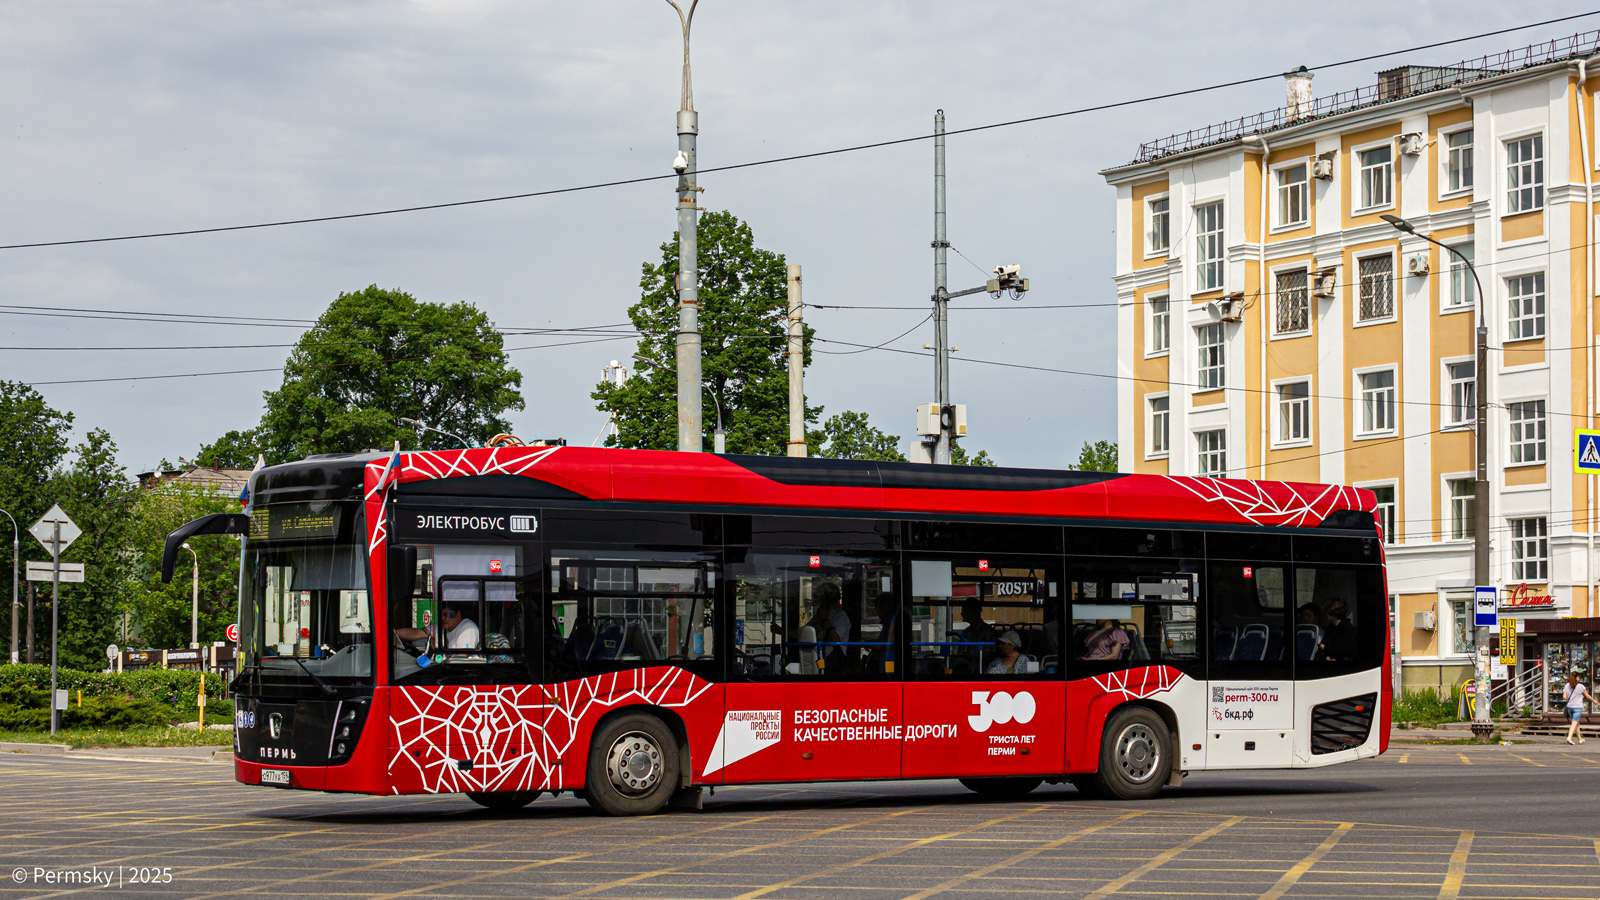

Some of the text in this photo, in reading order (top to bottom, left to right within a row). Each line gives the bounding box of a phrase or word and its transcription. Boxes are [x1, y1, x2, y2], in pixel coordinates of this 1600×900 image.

[417, 515, 505, 530] ЭЛЕКТРОБУС
[1512, 583, 1555, 606] Саша
[1500, 619, 1508, 664] ЦВЕТЫ
[1508, 619, 1516, 664] ЦВЕТЫ
[1225, 692, 1278, 704] perm-300.ru
[728, 711, 780, 722] НАЦИОНАЛЬНЫЕ
[794, 708, 888, 724] БЕЗОПАСНЫЕ
[967, 691, 1036, 732] 300
[1224, 708, 1254, 720] бкд.рф
[750, 721, 780, 731] ПРОЕКТЫ
[755, 731, 780, 741] РОССИИ
[794, 724, 957, 742] КАЧЕСТВЕННЫЕ ДОРОГИ
[988, 735, 1036, 744] ТРИСТА ЛЕТ
[260, 747, 297, 760] ПЕРМЬ
[987, 746, 1016, 756] ПЕРМИ
